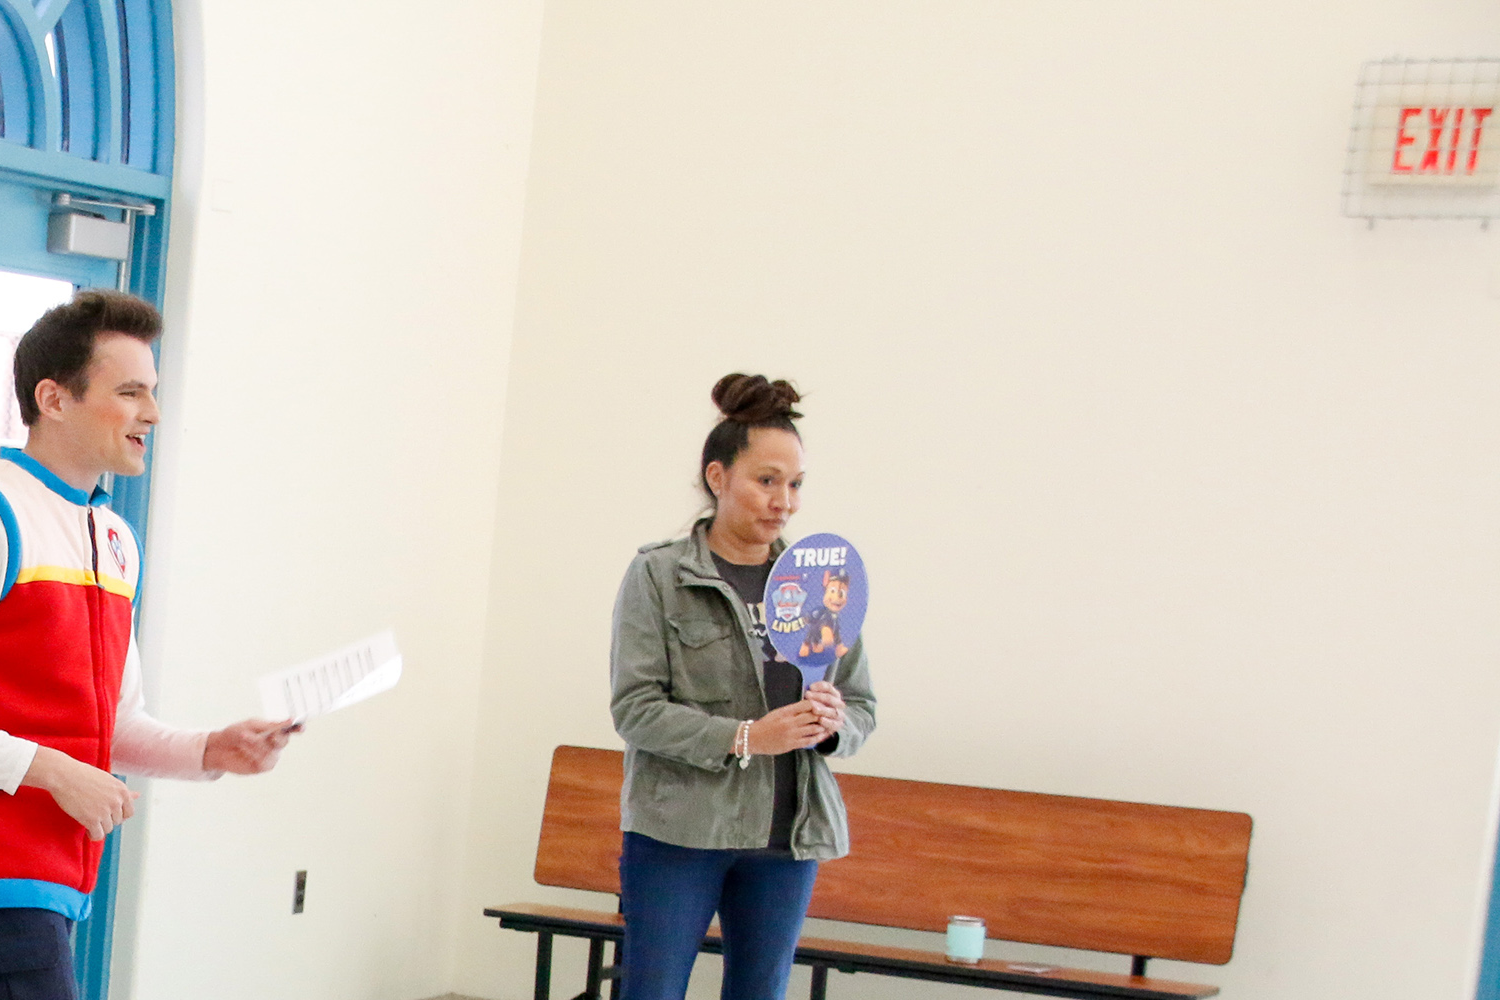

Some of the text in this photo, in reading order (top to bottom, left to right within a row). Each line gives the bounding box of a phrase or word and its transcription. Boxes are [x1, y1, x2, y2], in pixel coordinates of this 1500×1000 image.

[1391, 108, 1493, 174] EXIT
[793, 547, 847, 568] TRUE!
[771, 617, 805, 633] LIVE!
